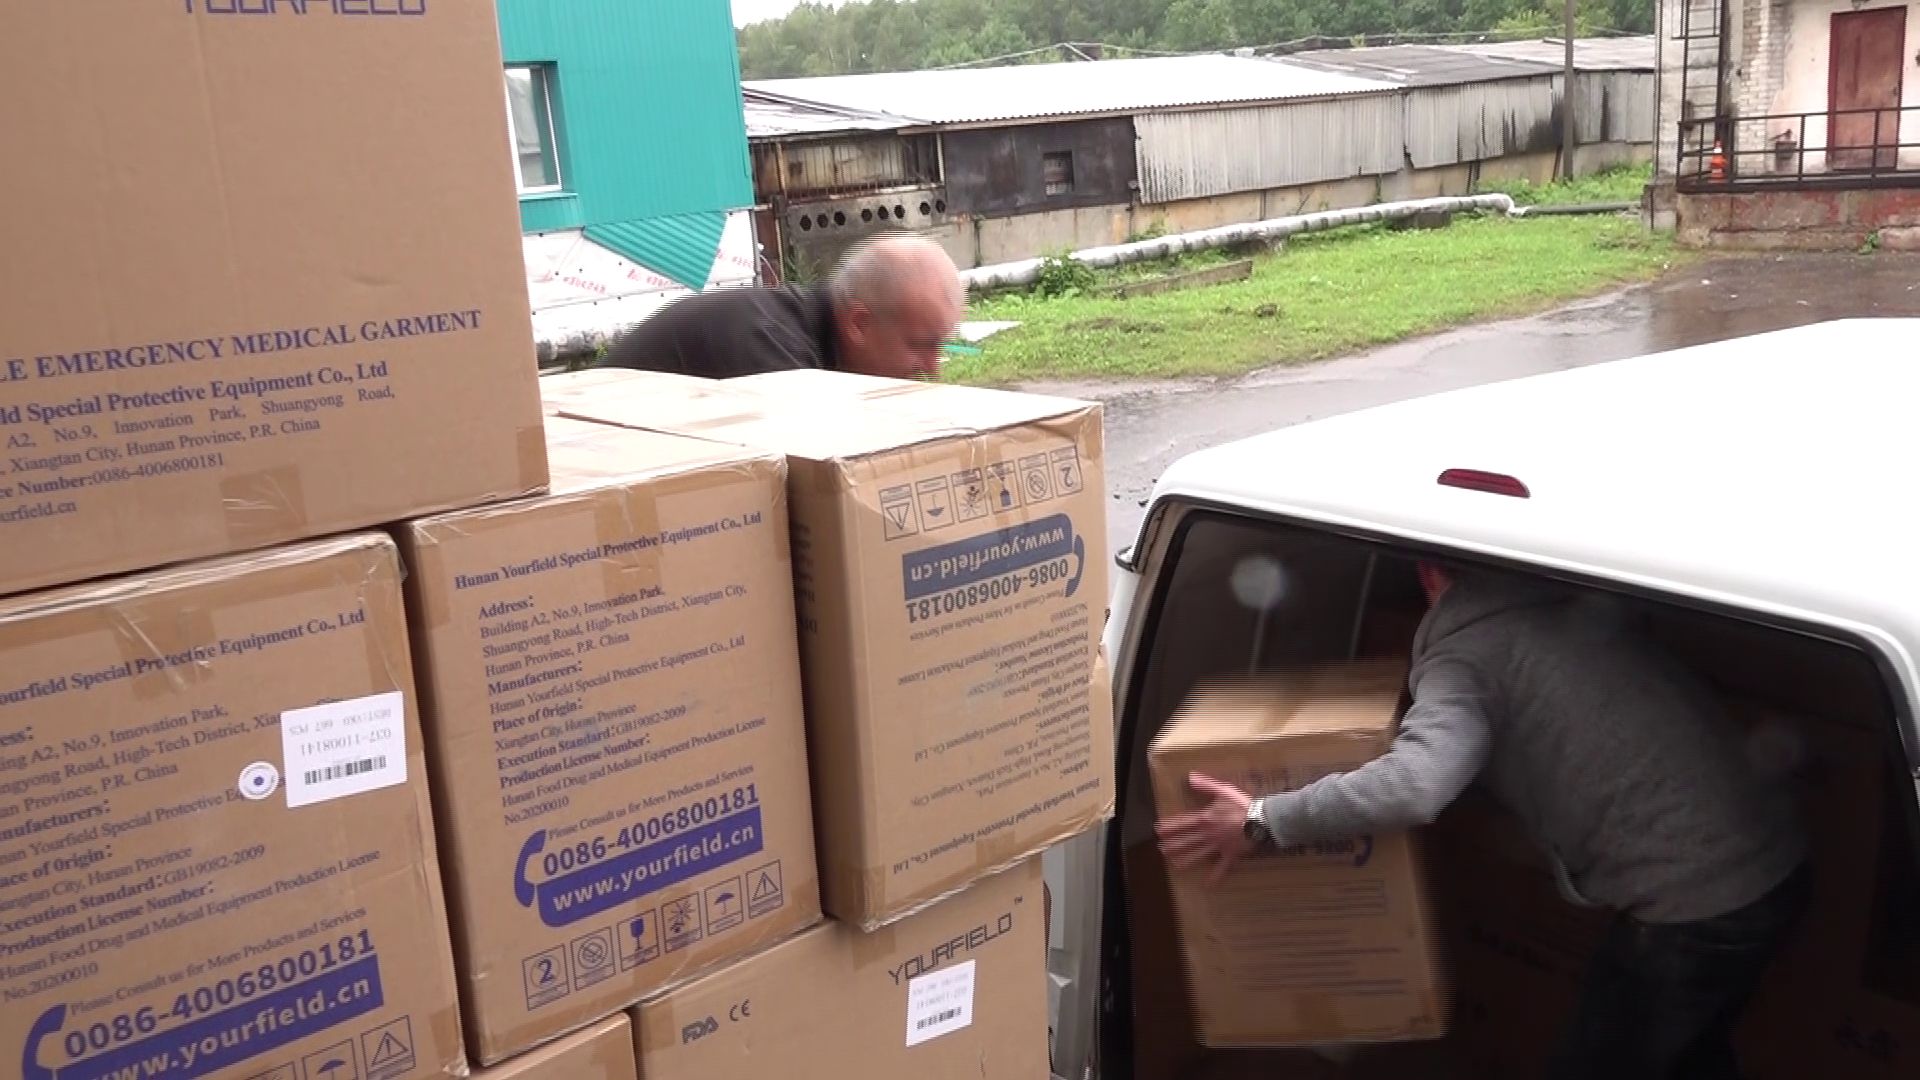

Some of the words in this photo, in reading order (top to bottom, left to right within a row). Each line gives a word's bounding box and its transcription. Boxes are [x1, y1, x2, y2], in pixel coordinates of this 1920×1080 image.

[0, 358, 28, 383] E
[35, 337, 225, 378] EMERGENCY
[231, 324, 357, 356] MEDICAL
[359, 310, 481, 342] GARMENT
[26, 395, 103, 424] Special
[106, 385, 206, 412] Protective
[210, 371, 314, 400] Equipment
[317, 366, 354, 385] Co.,
[356, 360, 388, 380] Ltd
[113, 412, 195, 434] Innovation
[260, 394, 345, 416] Shuangyong
[9, 452, 83, 473] Xiangtan
[125, 440, 176, 456] Hunan
[279, 418, 321, 434] China
[455, 571, 500, 590] Hunan
[500, 555, 558, 579] Yourfield
[559, 546, 602, 568] Special
[602, 535, 659, 558] Protective
[660, 521, 720, 545] Equipment
[719, 518, 742, 531] Co.,
[742, 511, 762, 526] Ltd
[911, 527, 1065, 582] www.yourfield.cn
[478, 594, 535, 620] Address:
[905, 558, 1069, 624] 0086-4006800181
[70, 661, 133, 690] Special
[134, 644, 216, 674] Protective
[219, 624, 305, 655] Equipment
[306, 618, 337, 634] Co.,
[337, 608, 366, 628] Ltd
[487, 660, 583, 696] Manufacturers:
[109, 715, 189, 744] Innovation
[133, 763, 179, 782] China
[543, 783, 759, 876] 0086-4006800181
[552, 826, 754, 912] www.yourfield.cn
[538, 958, 557, 984] 2
[887, 911, 1013, 986] YOURFIELD
[64, 928, 375, 1058] 0086-4006800181
[95, 978, 370, 1080] ww.yourfield.cn
[682, 1016, 719, 1045] FDA
